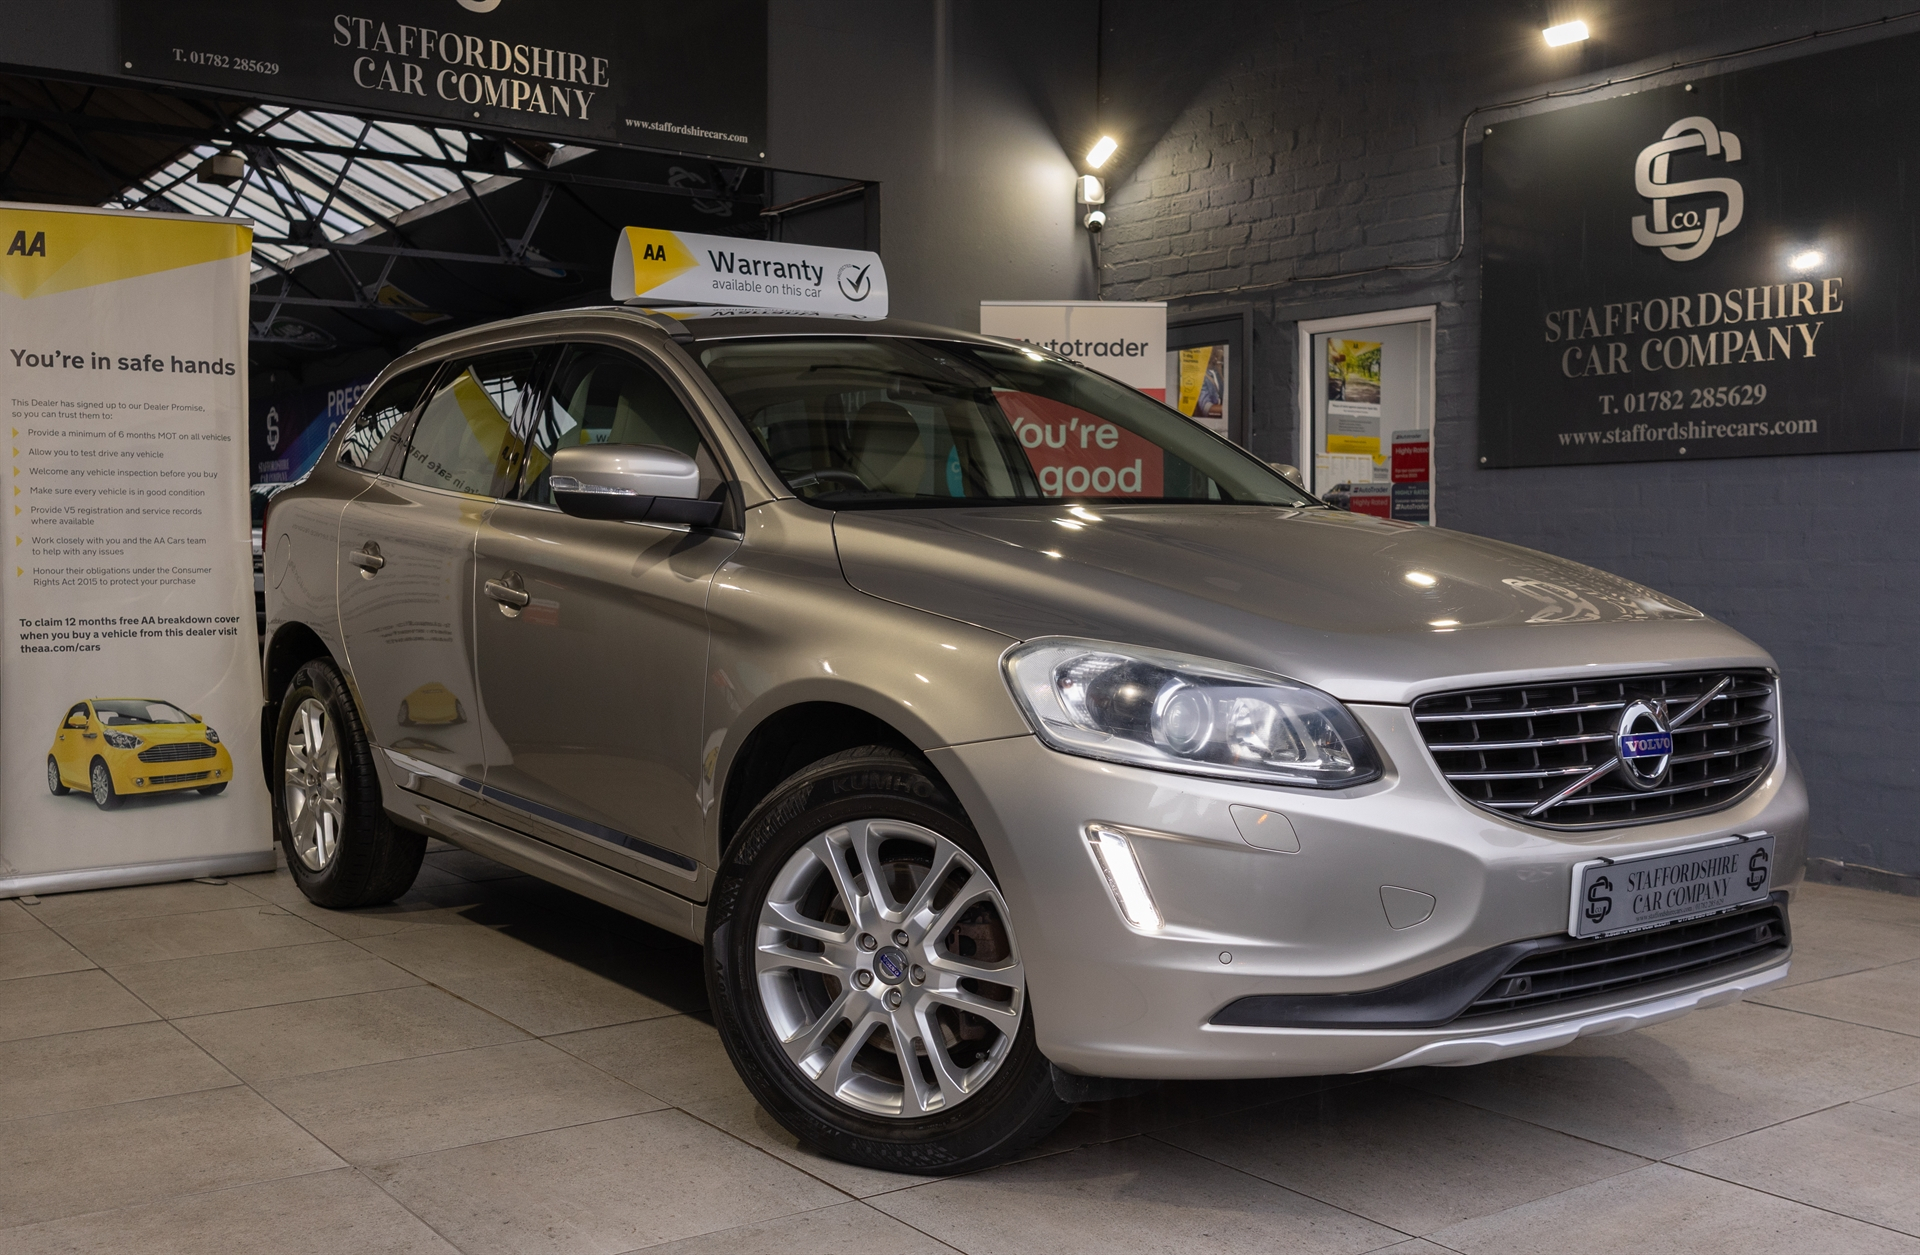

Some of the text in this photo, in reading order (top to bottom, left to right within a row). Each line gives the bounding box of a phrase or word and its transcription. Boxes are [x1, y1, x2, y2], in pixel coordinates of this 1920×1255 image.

[334, 14, 610, 88] STAFFORDSHIRE
[172, 48, 280, 76] T. 01782 285629
[353, 56, 595, 120] CAR COMPANY
[625, 118, 748, 144] www.staffordshirecars.com
[7, 230, 46, 258] AA
[643, 244, 666, 261] AA
[707, 250, 823, 286] Warranty
[712, 279, 822, 298] available on this car
[1544, 277, 1844, 343] STAFFORDSHIRE
[1562, 321, 1824, 378] CAR COMPANY
[91, 352, 111, 370] in
[118, 354, 164, 372] safe
[171, 355, 236, 376] hands
[11, 398, 30, 406] This
[31, 398, 58, 407] Dealer
[60, 400, 75, 408] has
[76, 401, 104, 410] signed
[143, 402, 169, 411] Dealer
[171, 403, 206, 412] Promise,
[1599, 384, 1767, 415] T. 01782 285629
[58, 411, 77, 419] trust
[79, 412, 100, 420] them
[102, 412, 113, 420] to:
[28, 428, 60, 437] Provide
[68, 430, 106, 438] minimum
[108, 430, 117, 438] of
[118, 430, 124, 438] 6
[126, 432, 156, 440] months
[158, 432, 177, 440] MOT
[201, 433, 232, 442] vehicles
[1558, 418, 1818, 446] www.staffordshirecars.com
[28, 448, 52, 456] Allow
[120, 451, 135, 459] any
[136, 450, 164, 458] vehicle
[29, 467, 69, 476] Welcome
[70, 469, 85, 478] any
[86, 468, 116, 476] vehicle
[117, 468, 158, 477] inspection
[160, 470, 186, 478] before
[203, 470, 218, 480] buy
[1039, 458, 1142, 498] good
[30, 486, 53, 494] Make
[74, 488, 97, 496] every
[98, 488, 127, 496] vehicle
[128, 488, 136, 496] is
[137, 488, 144, 496] in
[146, 488, 167, 498] good
[30, 506, 62, 514] Provide
[64, 506, 76, 514] V5
[77, 507, 124, 516] registration
[30, 517, 57, 525] where
[31, 536, 54, 544] Work
[56, 537, 85, 546] closely
[105, 538, 121, 546] you
[166, 536, 186, 544] Cars
[32, 548, 41, 556] to
[42, 548, 62, 556] help
[82, 549, 97, 557] any
[98, 548, 124, 556] issues
[32, 567, 64, 575] Honour
[66, 567, 84, 575] their
[86, 567, 131, 576] obligations
[171, 566, 212, 574] Consumer
[33, 578, 60, 588] Rights
[61, 578, 76, 586] Act
[77, 578, 98, 586] 2015
[99, 578, 108, 586] to
[110, 578, 139, 586] protect
[160, 577, 196, 586] purchase
[19, 616, 240, 627] To claim 12 months free AA breakdown cover
[20, 631, 49, 640] when
[51, 632, 70, 641] you
[72, 630, 91, 640] buy
[101, 629, 138, 638] vehicle
[140, 628, 163, 638] from
[165, 628, 184, 637] this
[185, 628, 217, 636] dealer
[218, 627, 238, 636] visit
[20, 643, 101, 654] theaa.com/cars
[1625, 737, 1670, 752] VOLVO
[1627, 853, 1740, 892] STAFFORDSHIRE
[1633, 891, 1661, 915] CAR
[1667, 877, 1731, 908] COMPANY
